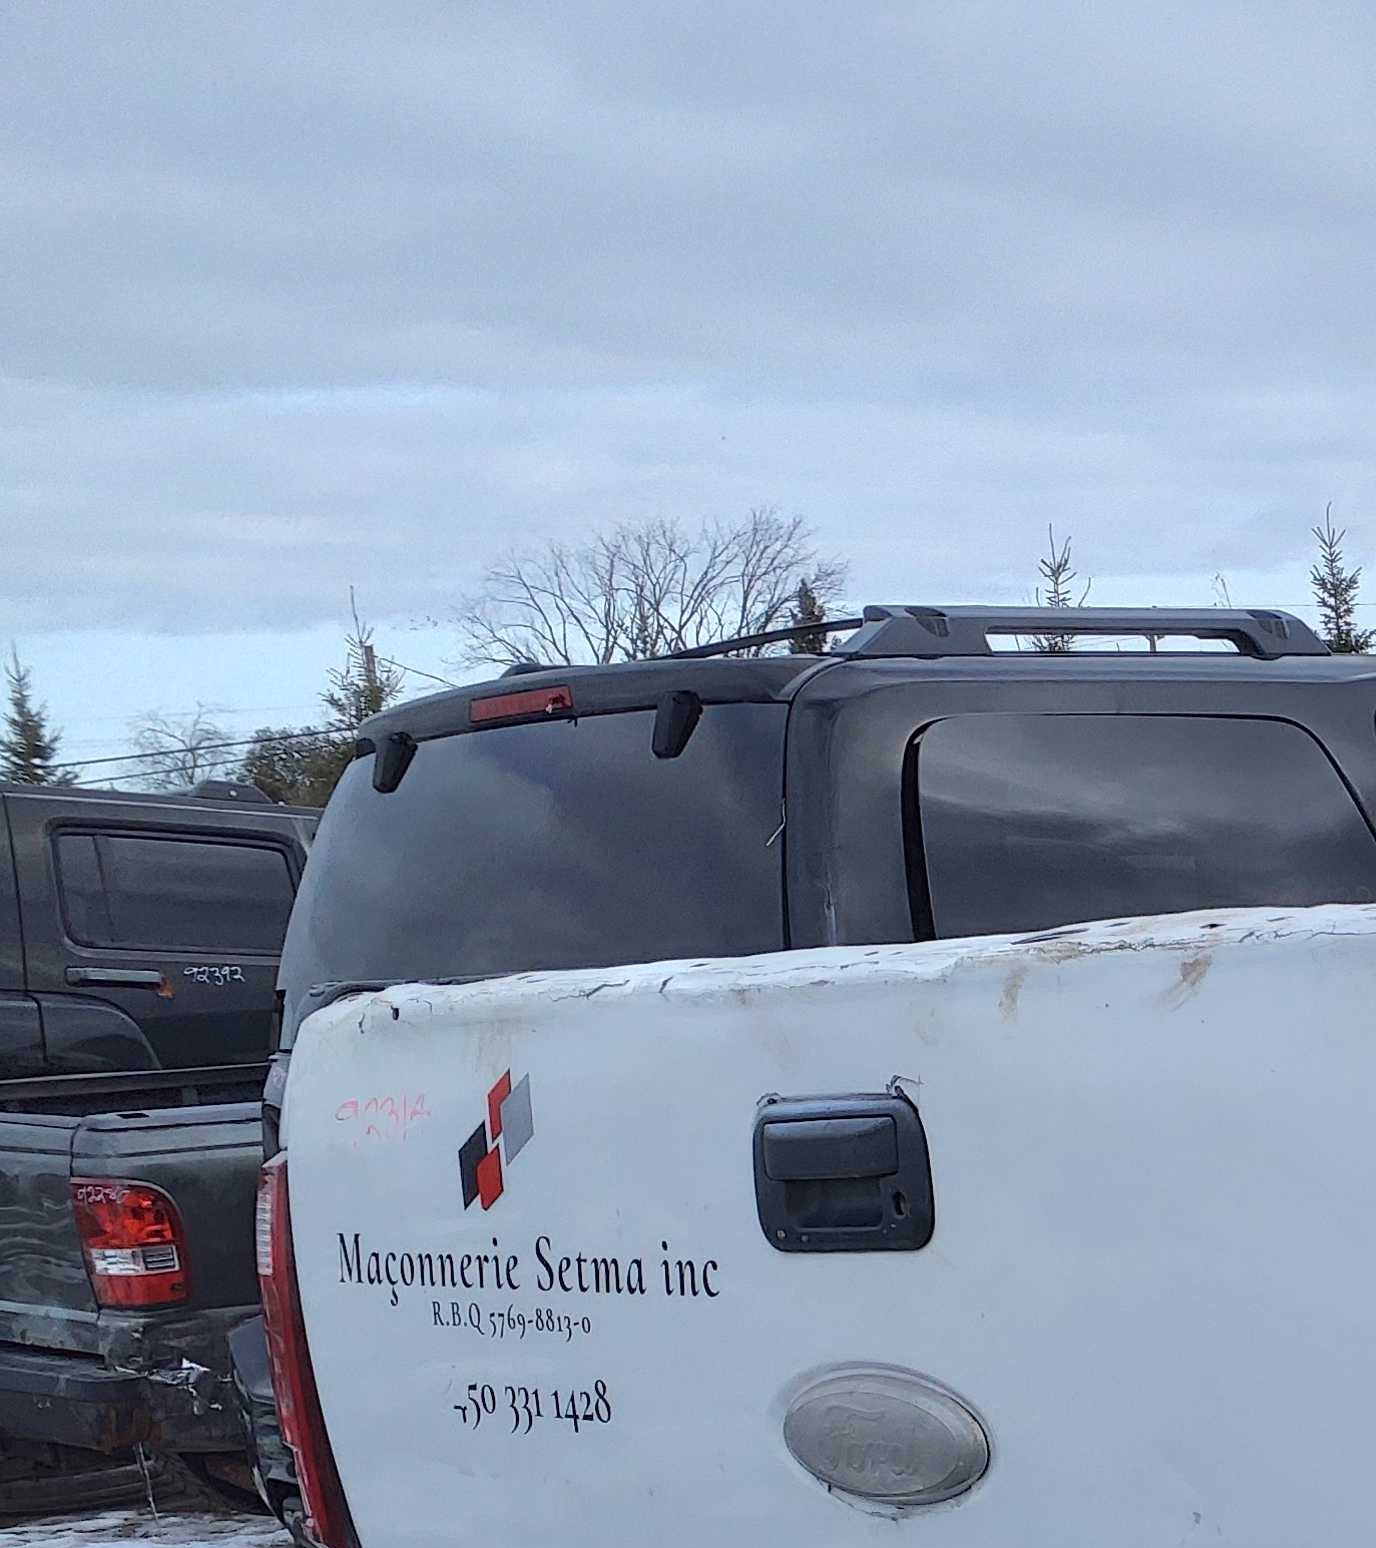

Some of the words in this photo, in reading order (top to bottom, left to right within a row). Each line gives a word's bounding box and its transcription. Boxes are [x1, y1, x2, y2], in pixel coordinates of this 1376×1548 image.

[183, 966, 246, 986] 92392
[336, 1231, 522, 1307] Maçonnerie
[535, 1235, 648, 1296] Setma
[660, 1240, 721, 1298] inc
[431, 1300, 485, 1335] R.B.Q
[489, 1303, 592, 1343] 5769-8813-0
[504, 1385, 545, 1435] 331
[551, 1379, 612, 1434] 1428
